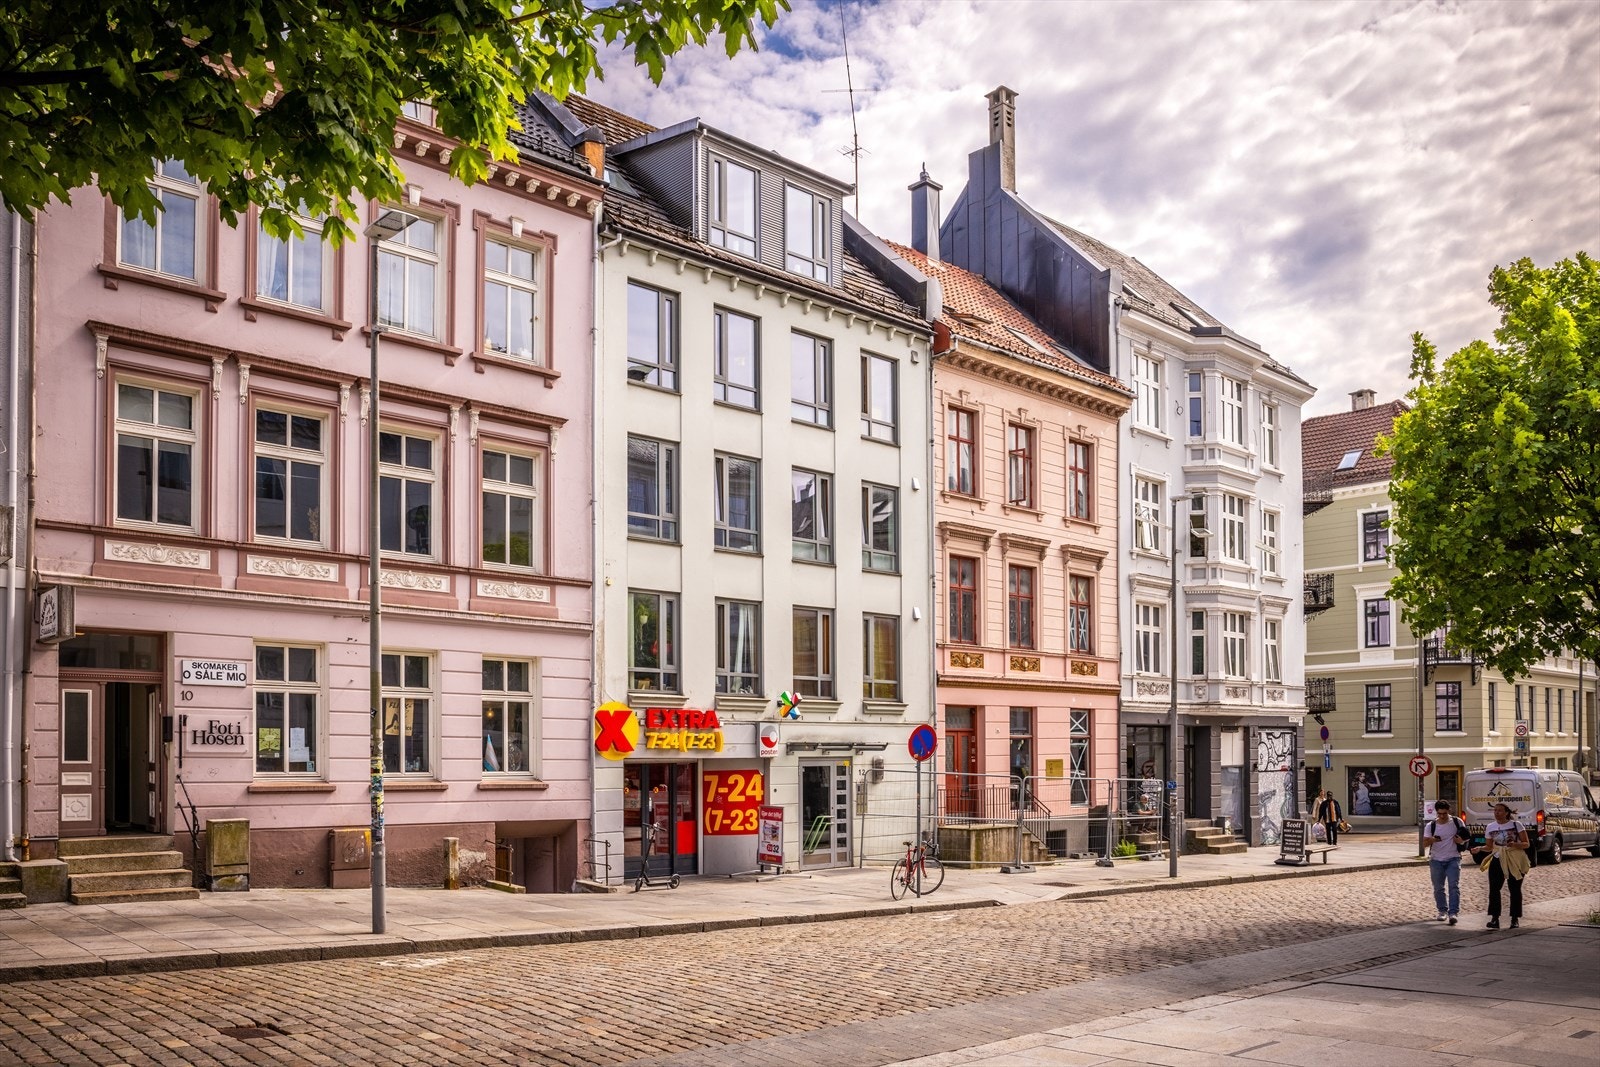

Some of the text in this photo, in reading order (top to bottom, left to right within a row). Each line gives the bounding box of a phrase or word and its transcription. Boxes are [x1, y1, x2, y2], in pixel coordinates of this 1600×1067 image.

[183, 670, 247, 681] O SÅLE MIO
[192, 662, 238, 671] SKOMAKER
[180, 690, 194, 701] 10
[208, 720, 242, 735] Fot i
[646, 708, 720, 729] EXTRA
[192, 730, 244, 745] Hosen
[595, 710, 635, 752] X
[645, 730, 724, 752] 7-24 (7-23)
[704, 774, 764, 802] 7-24
[705, 807, 760, 833] (7-23
